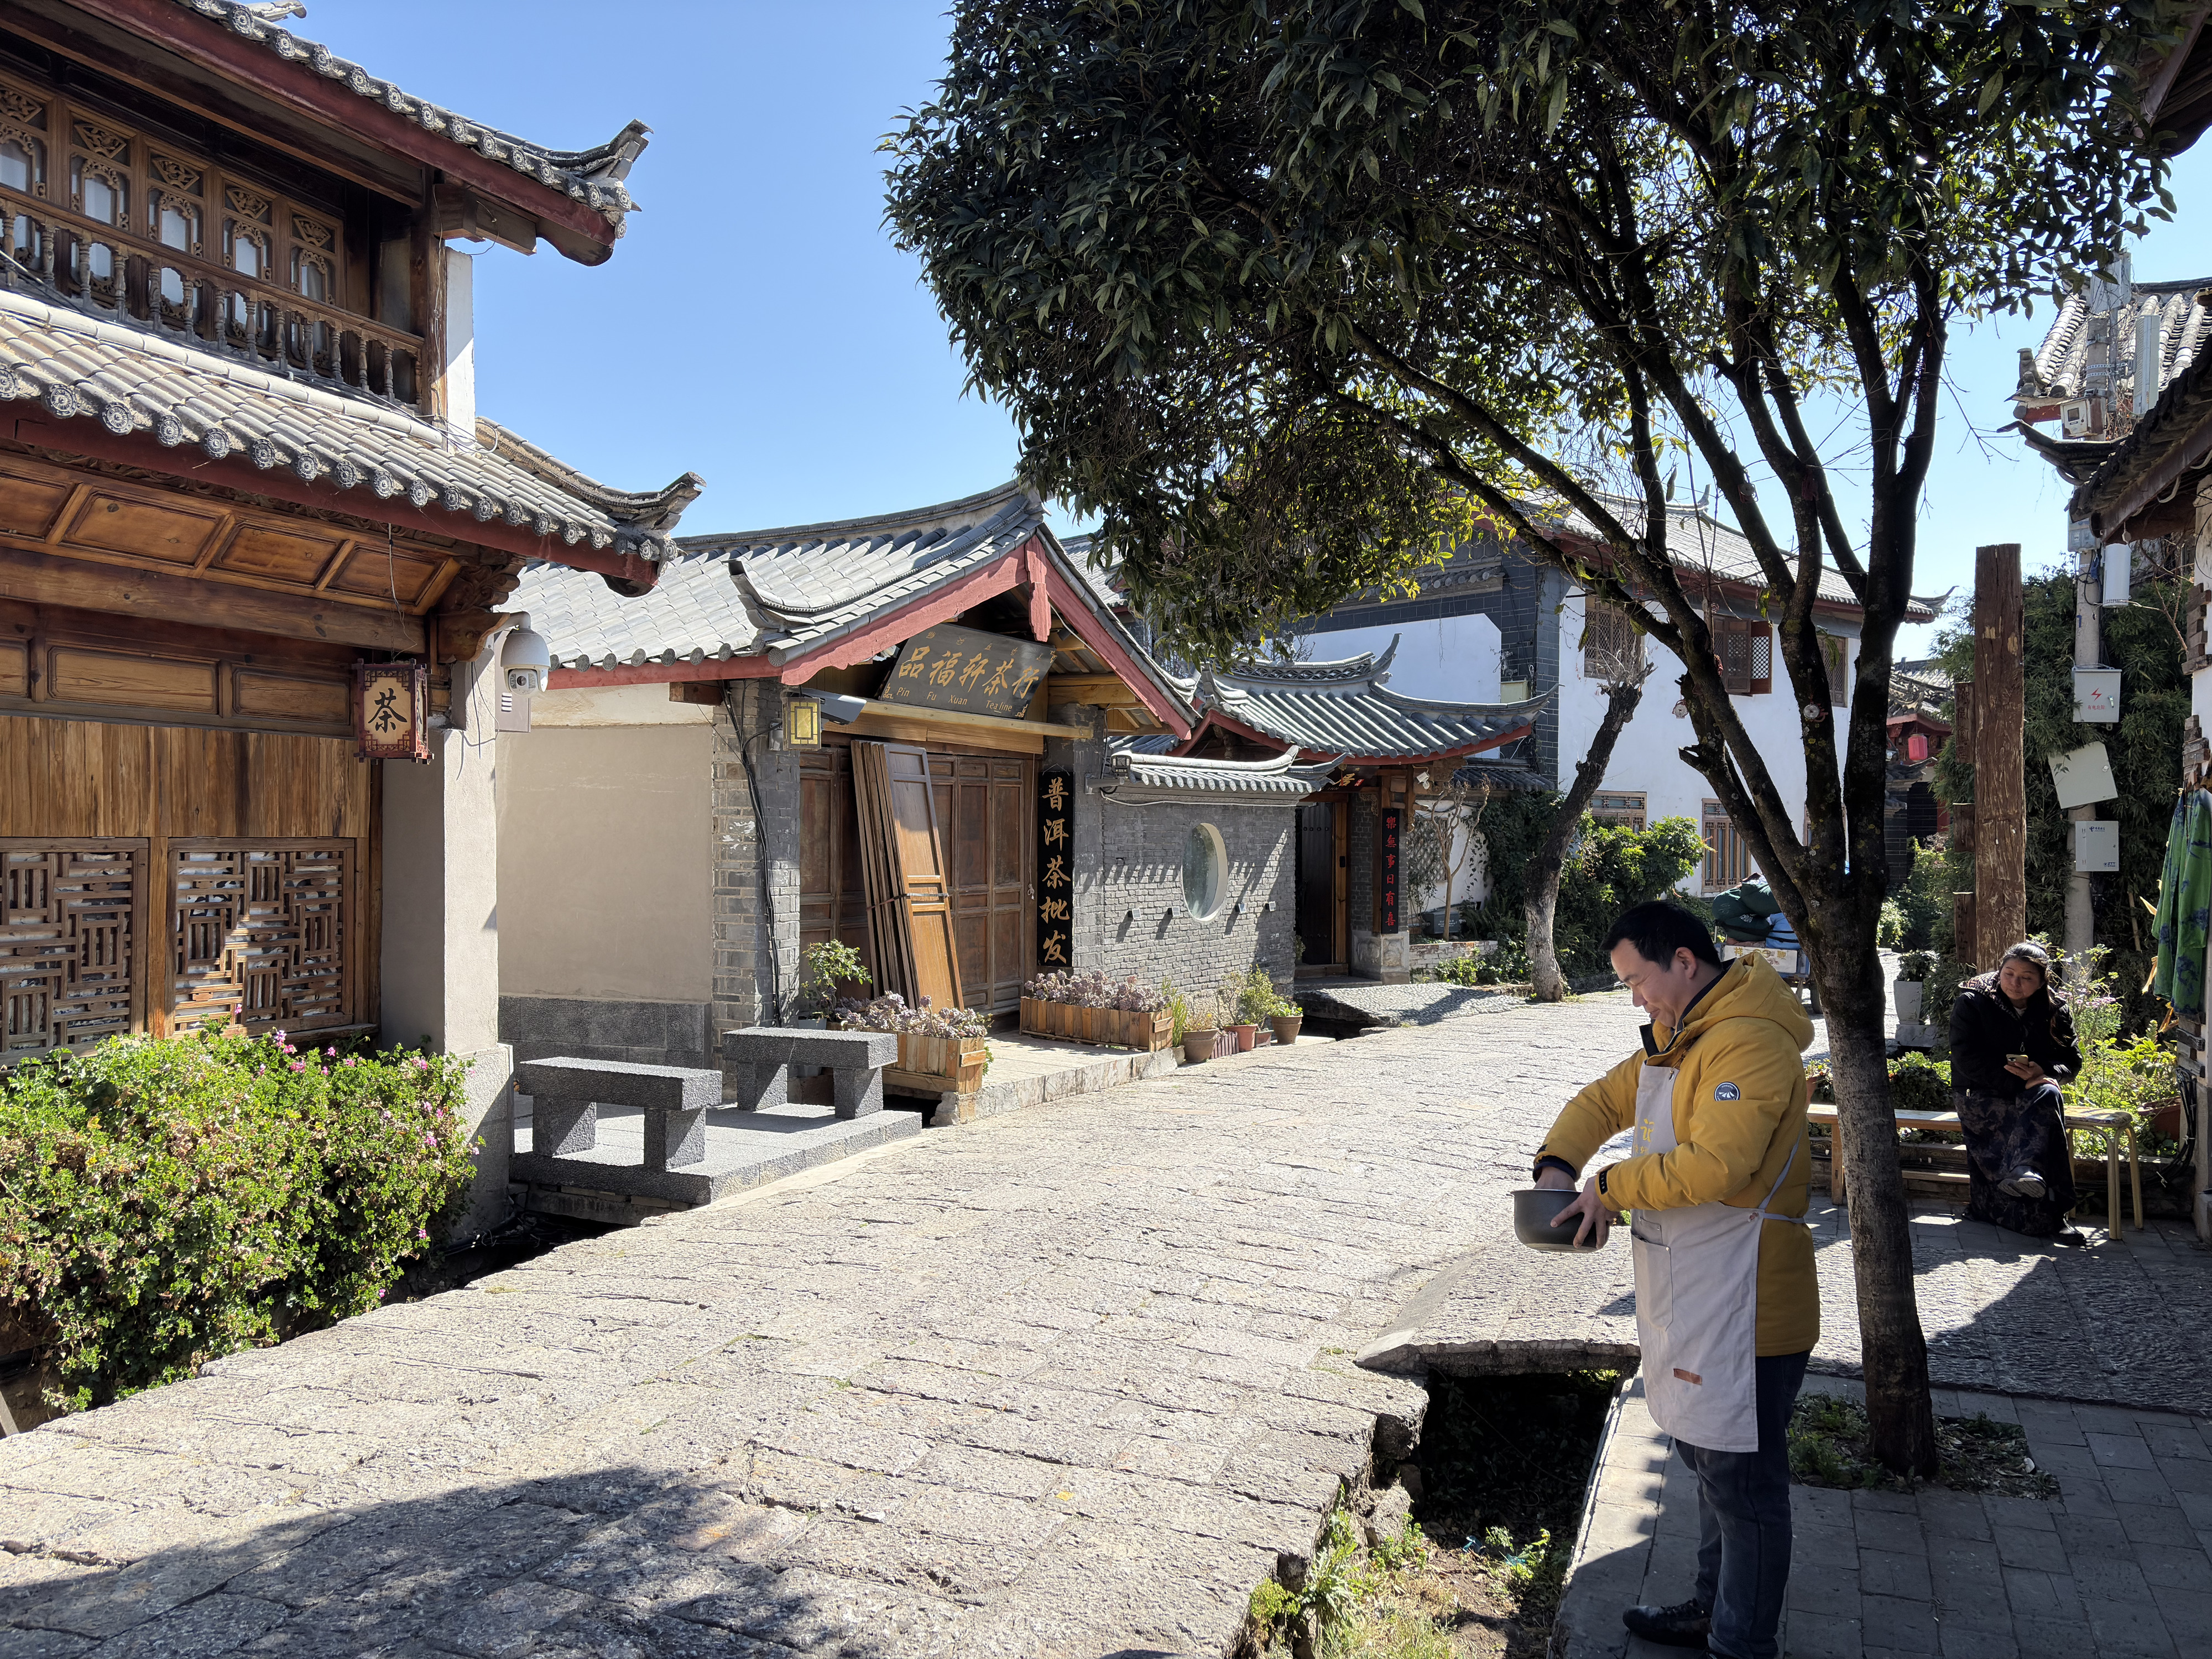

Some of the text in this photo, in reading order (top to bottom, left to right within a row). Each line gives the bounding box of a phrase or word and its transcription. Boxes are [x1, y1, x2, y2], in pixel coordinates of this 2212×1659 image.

[368, 687, 408, 734] 茶
[896, 687, 910, 697] Pin
[927, 691, 937, 701] Fu
[948, 695, 968, 706] Xuan
[1039, 776, 1071, 964] 普洱茶批发
[1385, 816, 1397, 927] 樂無事日有喜
